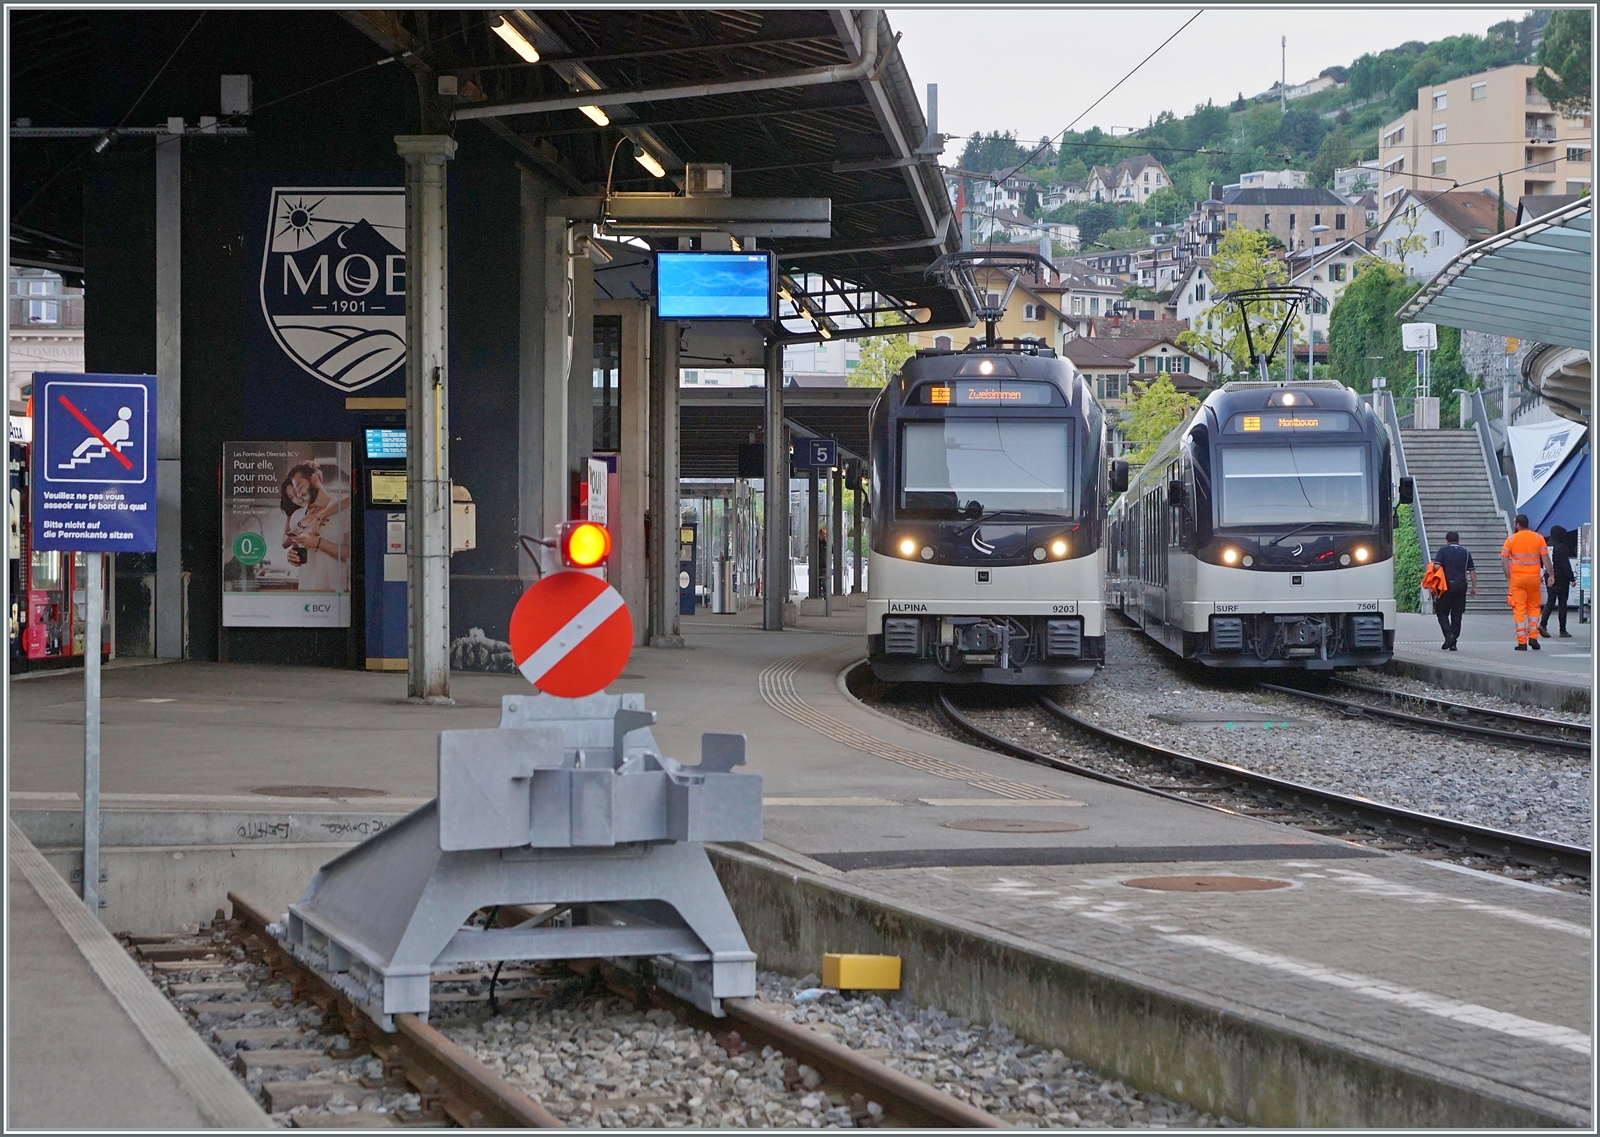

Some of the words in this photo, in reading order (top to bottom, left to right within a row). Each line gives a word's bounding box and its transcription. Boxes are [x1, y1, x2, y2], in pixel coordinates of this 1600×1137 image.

[332, 300, 366, 313] 1901
[968, 388, 1022, 400] Zweisimmen
[816, 447, 828, 463] 5
[233, 460, 255, 469] Pour
[257, 459, 274, 470] elle,
[233, 474, 255, 484] pour
[257, 472, 278, 482] moi,
[43, 491, 75, 500] Veuillez
[88, 493, 104, 501] pas
[105, 493, 125, 501] vous
[233, 486, 255, 496] pour
[257, 486, 279, 494] nous
[43, 501, 73, 510] asseoir
[74, 502, 88, 510] sur
[89, 502, 96, 510] le
[98, 502, 116, 510] bord
[117, 502, 128, 511] du
[129, 502, 147, 512] quai
[43, 520, 63, 529] Bitte
[64, 520, 85, 529] nicht
[86, 520, 101, 529] auf
[43, 530, 56, 538] die
[57, 530, 108, 539] Perronkante
[109, 531, 134, 540] sitzen
[312, 604, 331, 613] BCV
[890, 603, 928, 612] ALPINA
[1052, 604, 1075, 613] 9203
[1216, 604, 1239, 612] SURF
[1357, 603, 1377, 611] 7506
